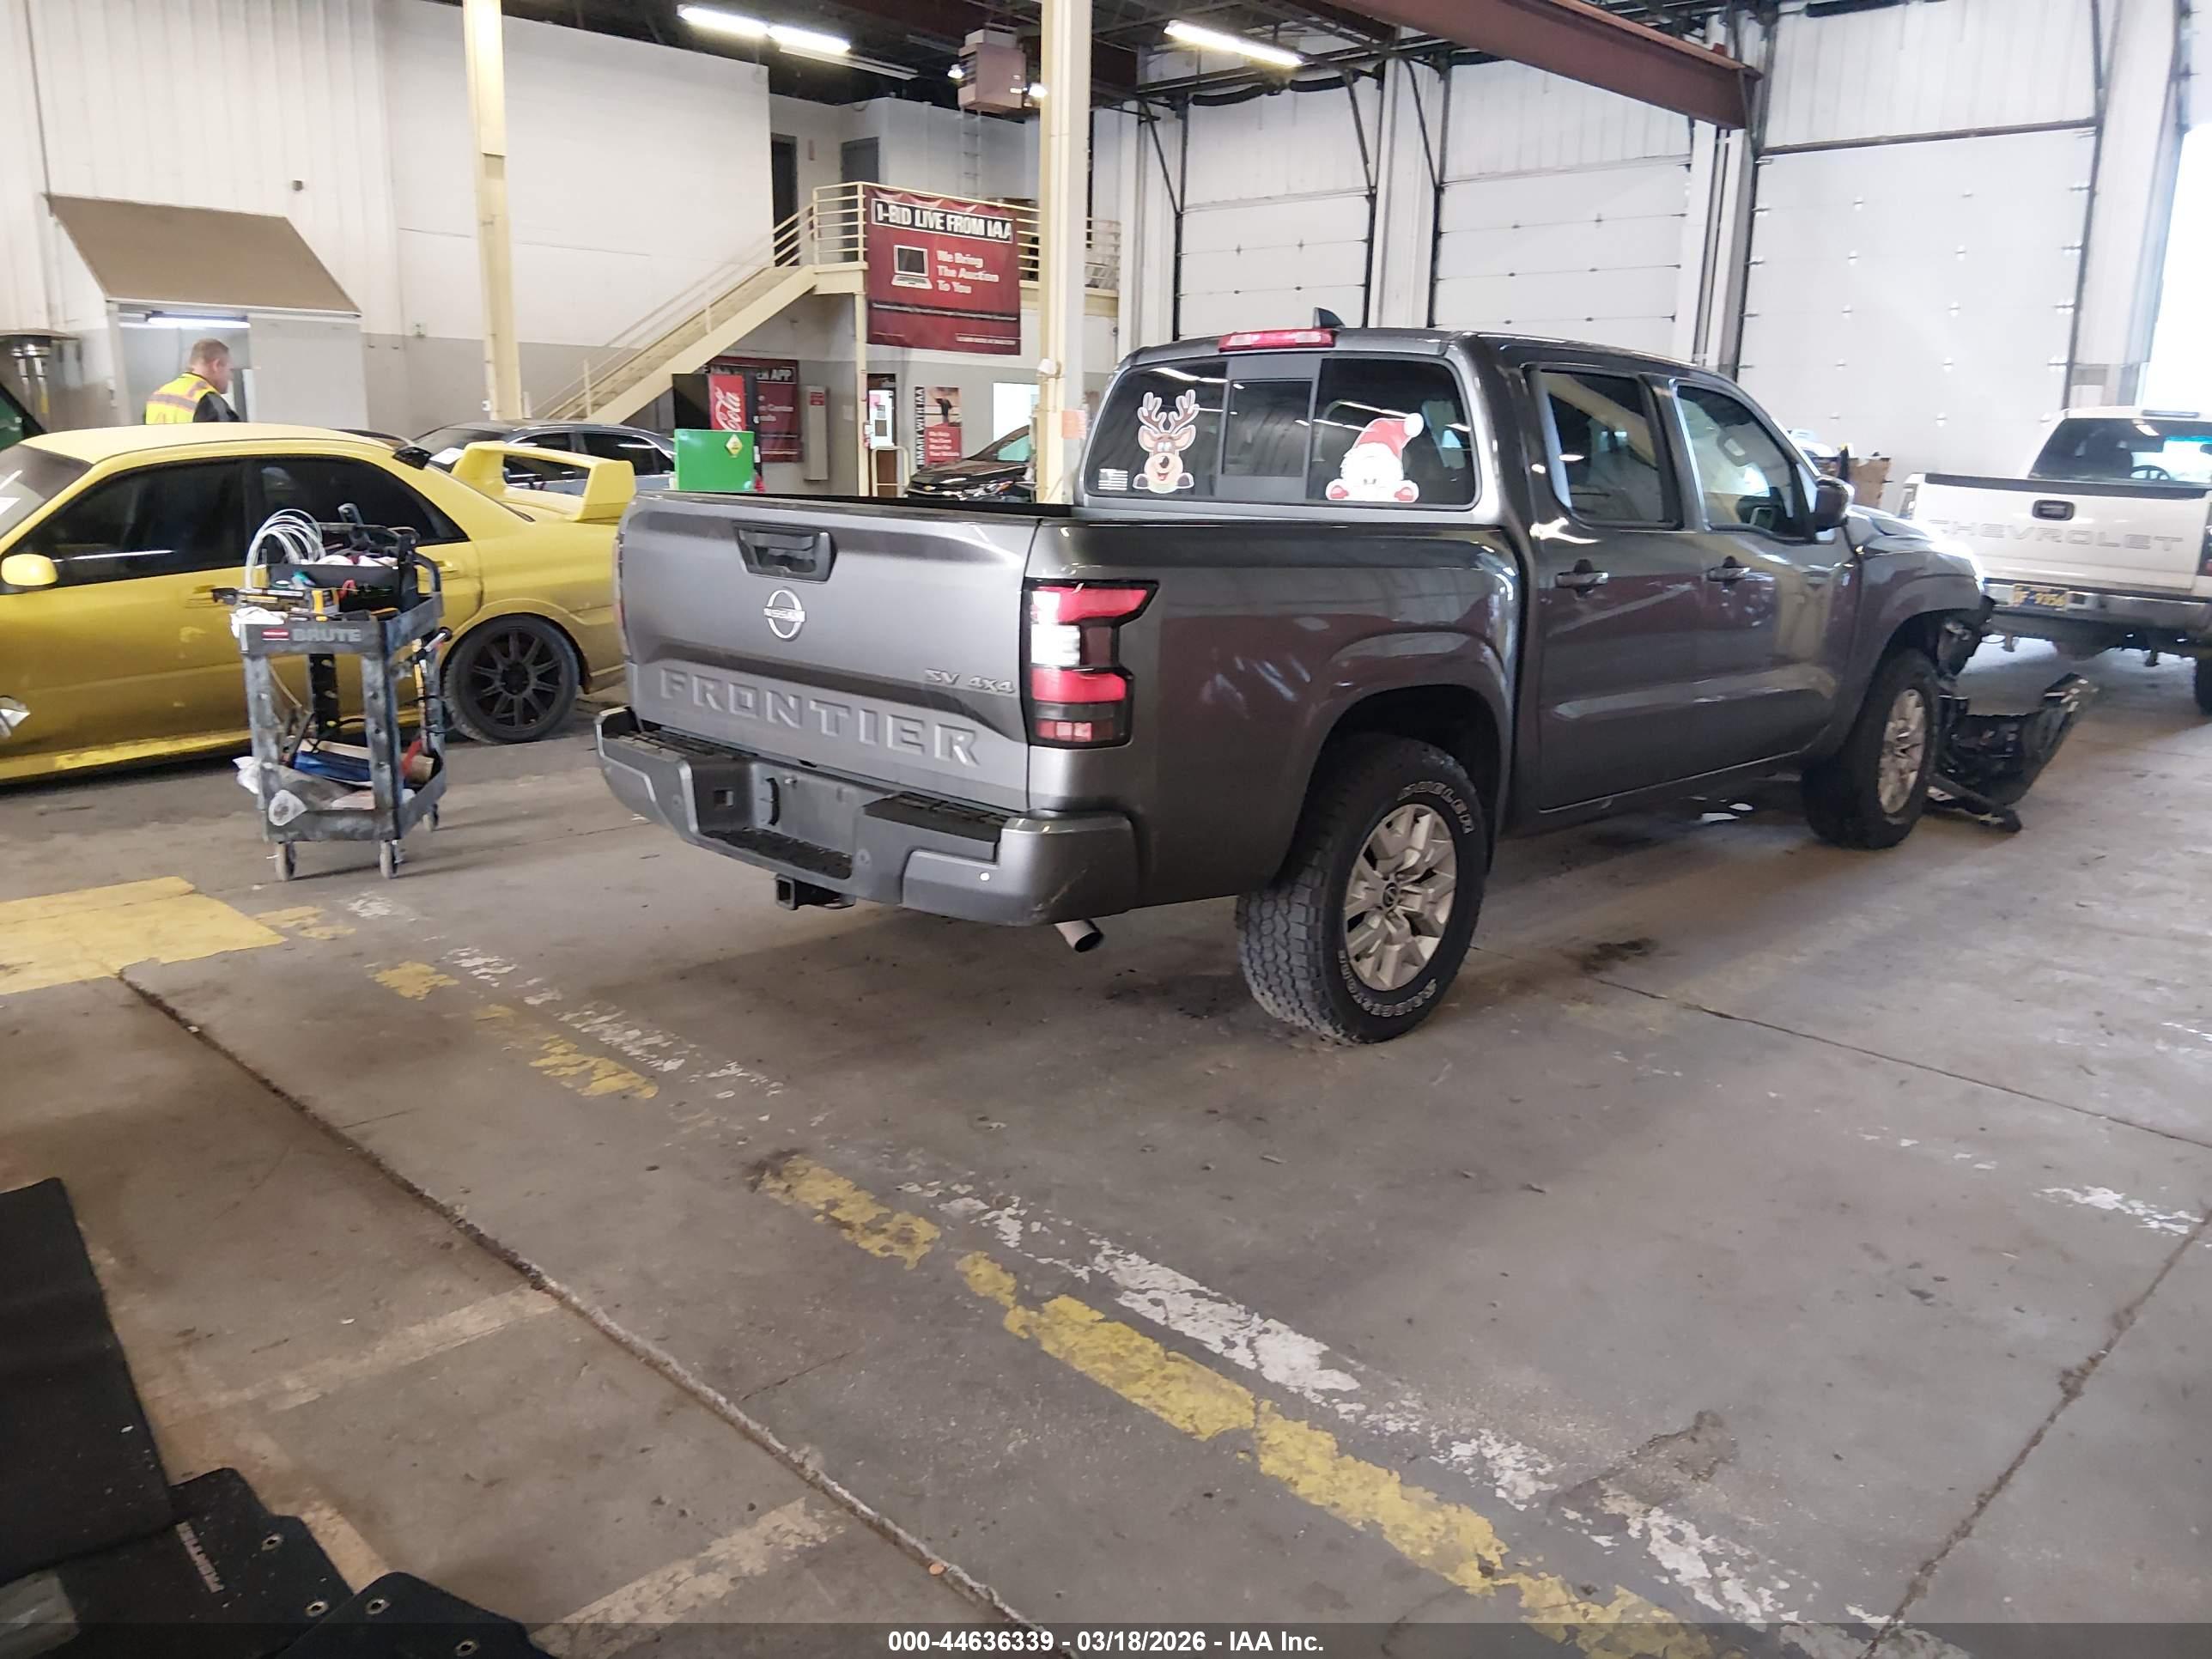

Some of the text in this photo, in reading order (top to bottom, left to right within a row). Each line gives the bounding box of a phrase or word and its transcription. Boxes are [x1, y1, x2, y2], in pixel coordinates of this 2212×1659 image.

[915, 210, 945, 230] LIVE
[946, 214, 985, 235] FROM
[987, 220, 1012, 240] IAA
[936, 265, 1000, 283] The Auction
[952, 282, 972, 294] You
[1929, 520, 2183, 551] CHEVROLET
[293, 629, 362, 642] BRUTE
[925, 668, 960, 685] SV
[659, 667, 980, 767] FRONTIER
